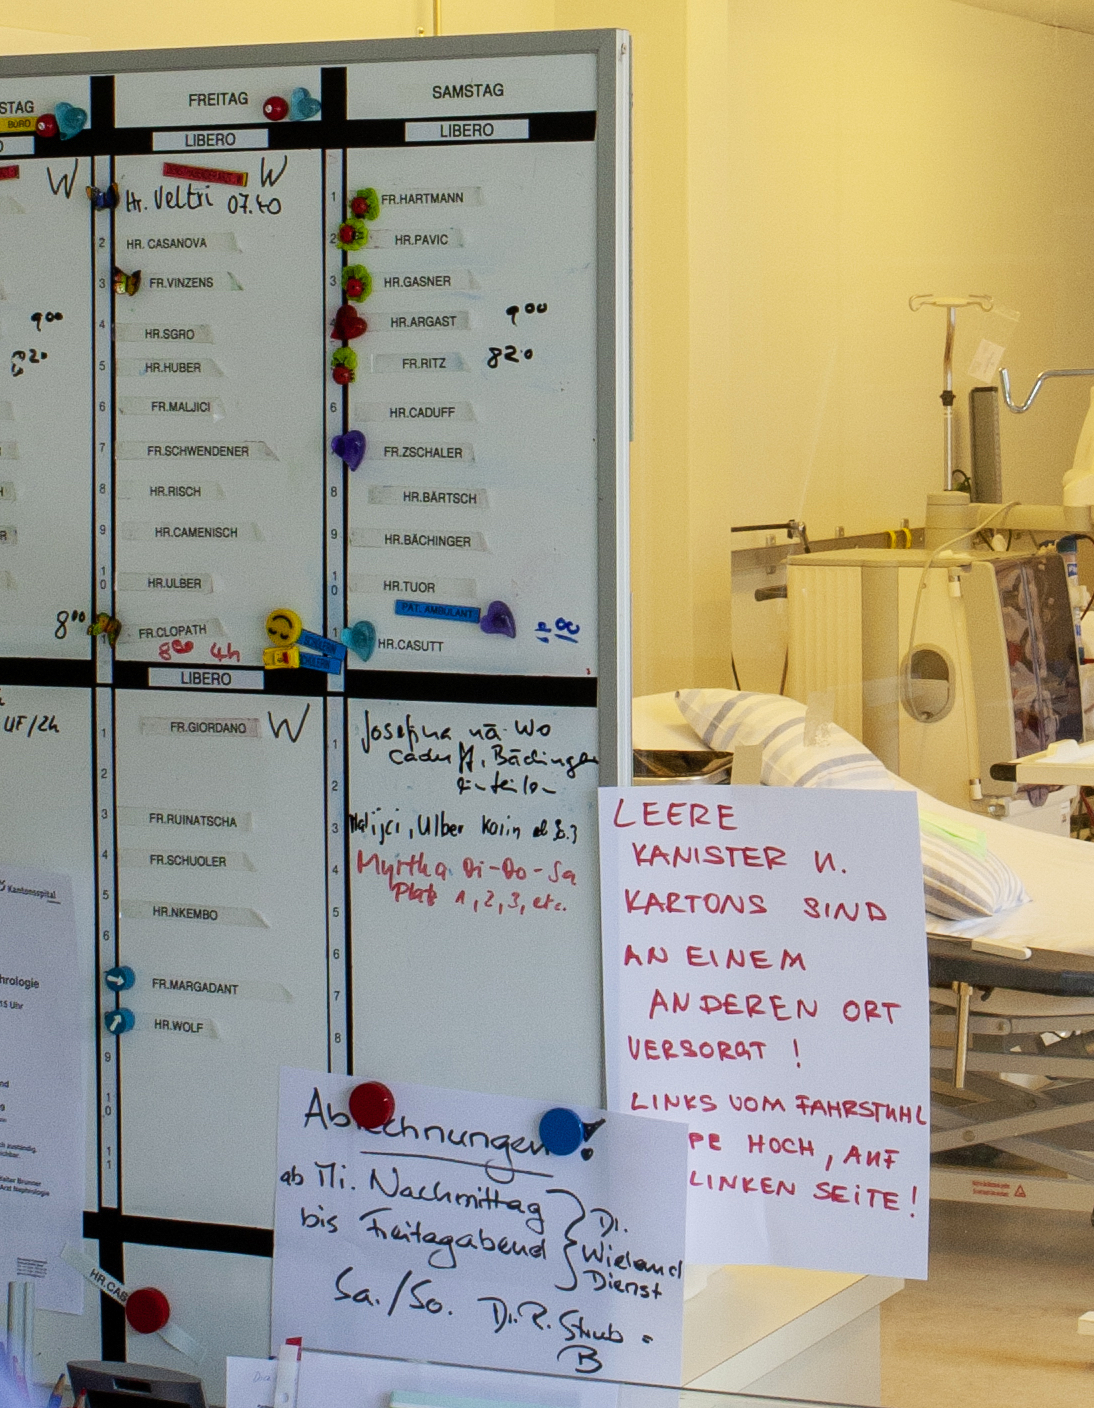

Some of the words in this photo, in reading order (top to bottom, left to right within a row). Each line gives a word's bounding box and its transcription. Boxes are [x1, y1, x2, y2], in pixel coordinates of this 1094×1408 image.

[432, 83, 504, 99] SAMSTAG
[189, 92, 249, 107] FREITAG
[439, 123, 494, 138] LIBERO
[185, 132, 236, 147] LIBERO
[47, 158, 79, 199] W
[260, 155, 288, 187] W
[381, 192, 464, 205] FR.HARTMANN
[126, 239, 145, 250] HR.
[147, 237, 207, 250] CASANOVA
[394, 234, 449, 246] HR.PAVIC
[149, 277, 214, 288] FR.VINZENS
[384, 276, 451, 288] HR.GASNER
[390, 315, 457, 328] HR.ARGAST
[145, 328, 195, 340] HR.SGRO
[145, 362, 202, 373] HR.HUBER
[402, 357, 446, 369] FR.RITZ
[151, 401, 211, 413] FR.MALJICI
[389, 407, 456, 419] HR.CADUFF
[147, 446, 250, 457] FR.SCHWENDENER
[384, 446, 463, 459] FR.ZSCHALER
[150, 486, 202, 497] HR.RISCH
[403, 491, 477, 504] HR.BÄRTSCH
[155, 527, 238, 538] HR.CAMENISCH
[384, 533, 472, 547] HR.BÄCHINGER
[147, 578, 202, 589] HR.ULBER
[383, 580, 436, 593] HR.TUOR
[138, 624, 207, 640] FR.CLOPATH
[378, 638, 444, 652] HR.CASUTT
[181, 671, 232, 686] LIBERO
[170, 721, 247, 734] FR.GIORDANO
[267, 703, 310, 743] W
[149, 812, 238, 828] FR.RUINATSCHA
[613, 798, 738, 831] LEERE
[149, 854, 227, 867] FR.SCHUOLER
[632, 842, 788, 870] KANISTER
[624, 888, 768, 915] KARTONS
[803, 896, 888, 922] SIND
[152, 905, 218, 921] HR.NKEMBO
[624, 944, 669, 967] AN
[686, 945, 806, 971] EINEM
[152, 978, 239, 995] FR.MARGADANT
[649, 988, 818, 1021] ANDEREN
[842, 999, 902, 1024] ORT
[154, 1018, 204, 1034] HR.WOLF
[627, 1035, 767, 1061] VERSORGT
[631, 1092, 718, 1112] LINKS
[728, 1094, 786, 1112] VOM
[795, 1094, 928, 1126] FAHRSTUHL
[843, 1145, 900, 1170] AUF
[689, 1170, 796, 1197] LINKEN
[280, 1166, 304, 1187] ab
[370, 1168, 546, 1235] Nachmittag
[301, 1207, 338, 1234] bis
[359, 1208, 547, 1269] Freitagabend
[582, 1244, 683, 1279] Wieland
[583, 1270, 663, 1300] Dienst
[559, 1309, 624, 1345] Strub
[557, 1345, 603, 1373] B
